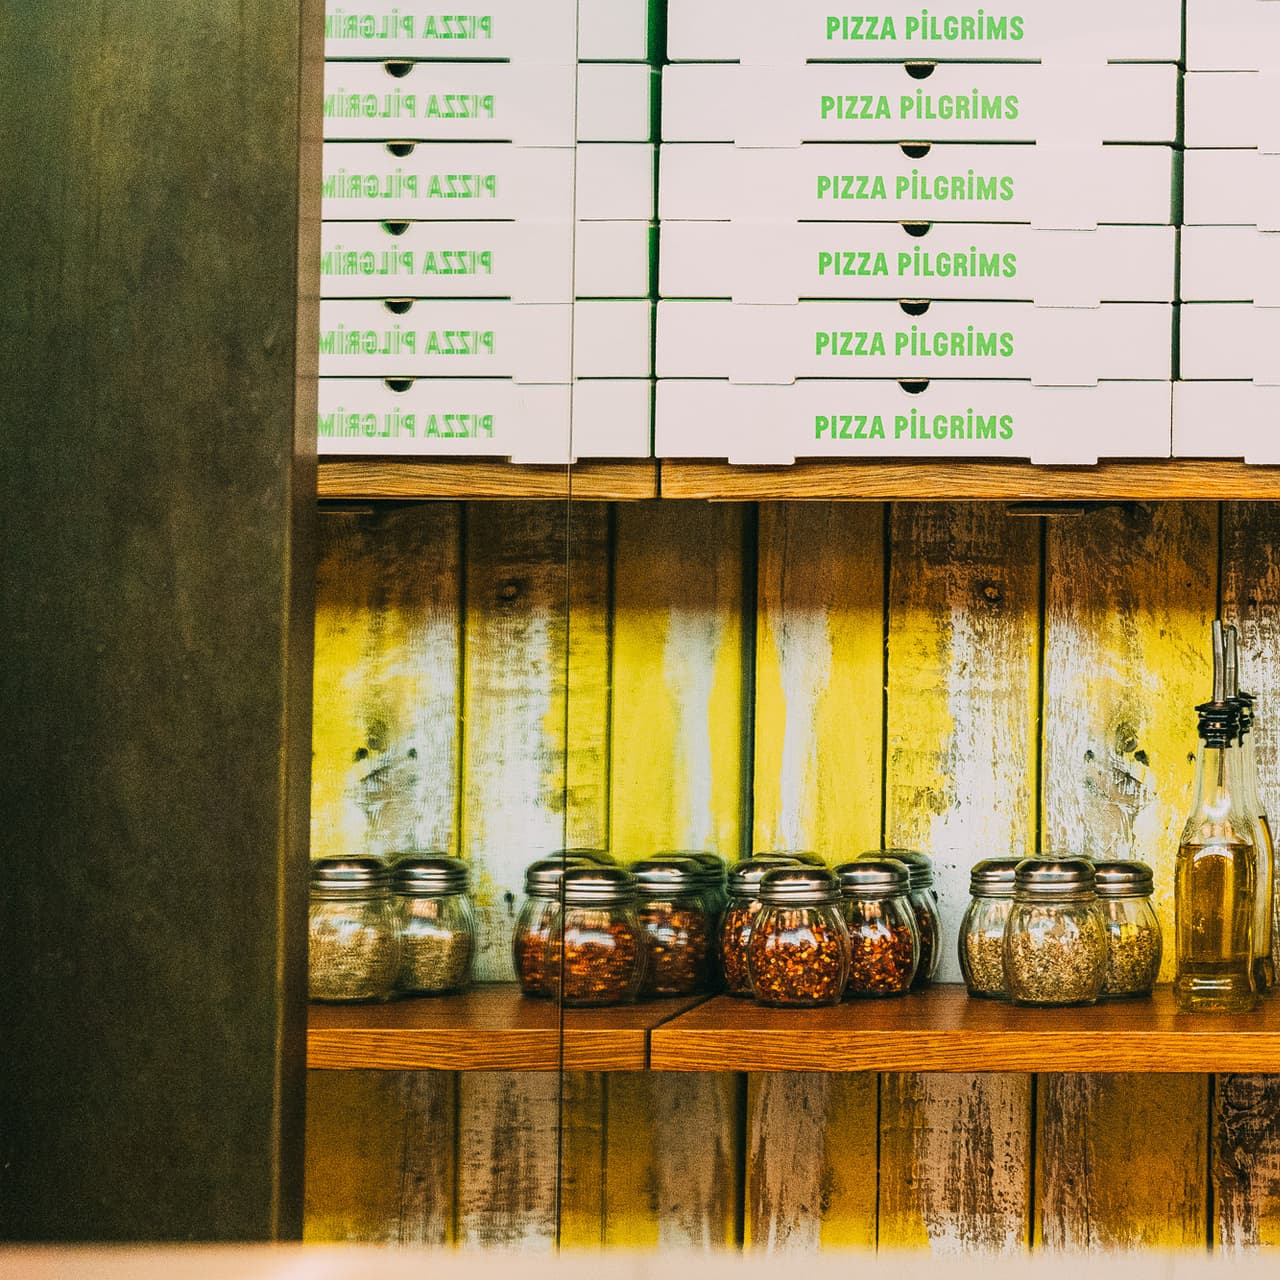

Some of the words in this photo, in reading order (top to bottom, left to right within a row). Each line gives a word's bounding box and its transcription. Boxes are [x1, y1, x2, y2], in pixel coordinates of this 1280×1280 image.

[821, 96, 891, 119] PIZZA
[818, 176, 886, 199] PIZZA
[816, 332, 885, 355] PIZZA
[816, 416, 885, 439] PIZZA
